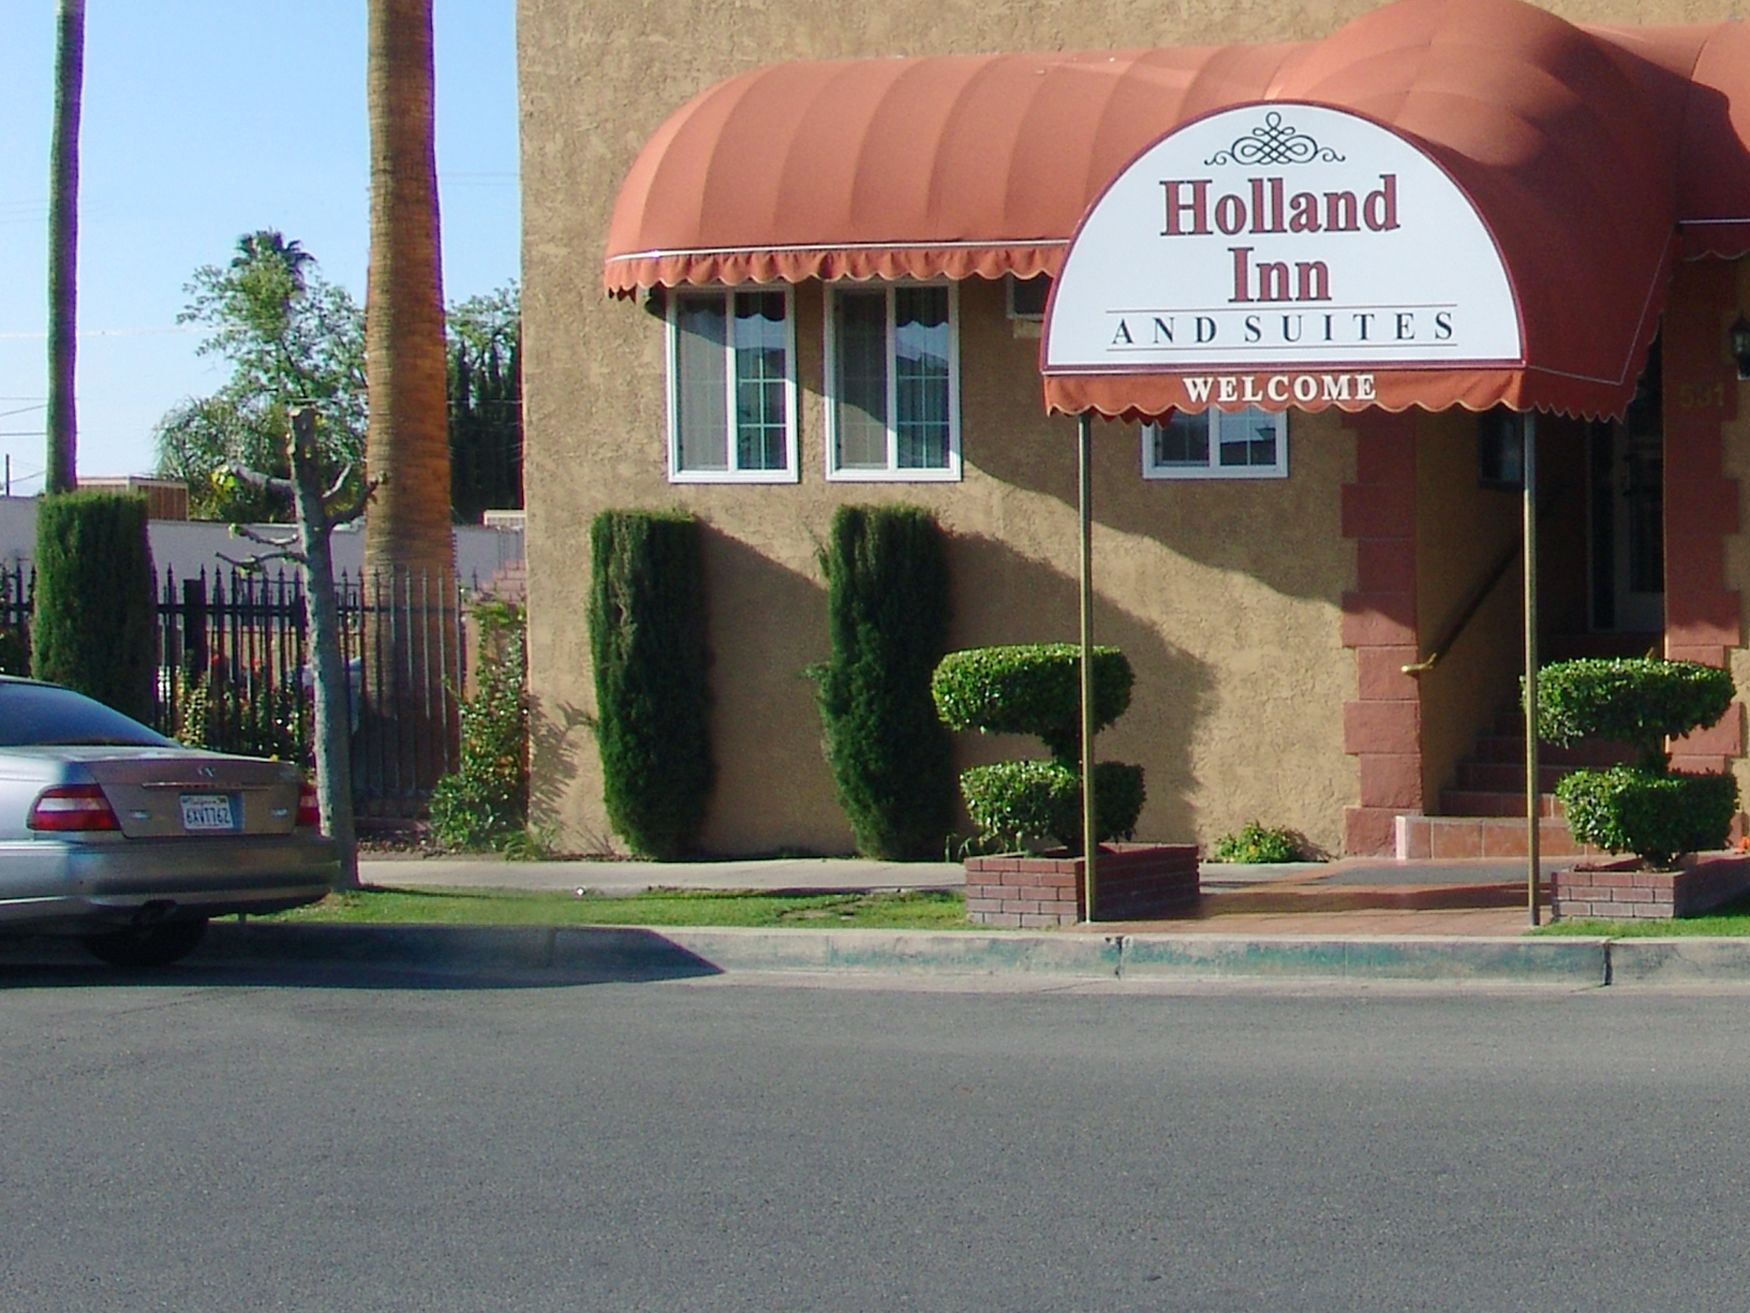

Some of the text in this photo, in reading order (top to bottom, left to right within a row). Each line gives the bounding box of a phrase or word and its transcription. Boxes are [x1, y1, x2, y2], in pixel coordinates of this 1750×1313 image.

[1159, 174, 1400, 236] Holland
[1227, 246, 1333, 304] Inn
[1112, 312, 1453, 344] AND SUITES
[1182, 375, 1377, 403] WELCOME
